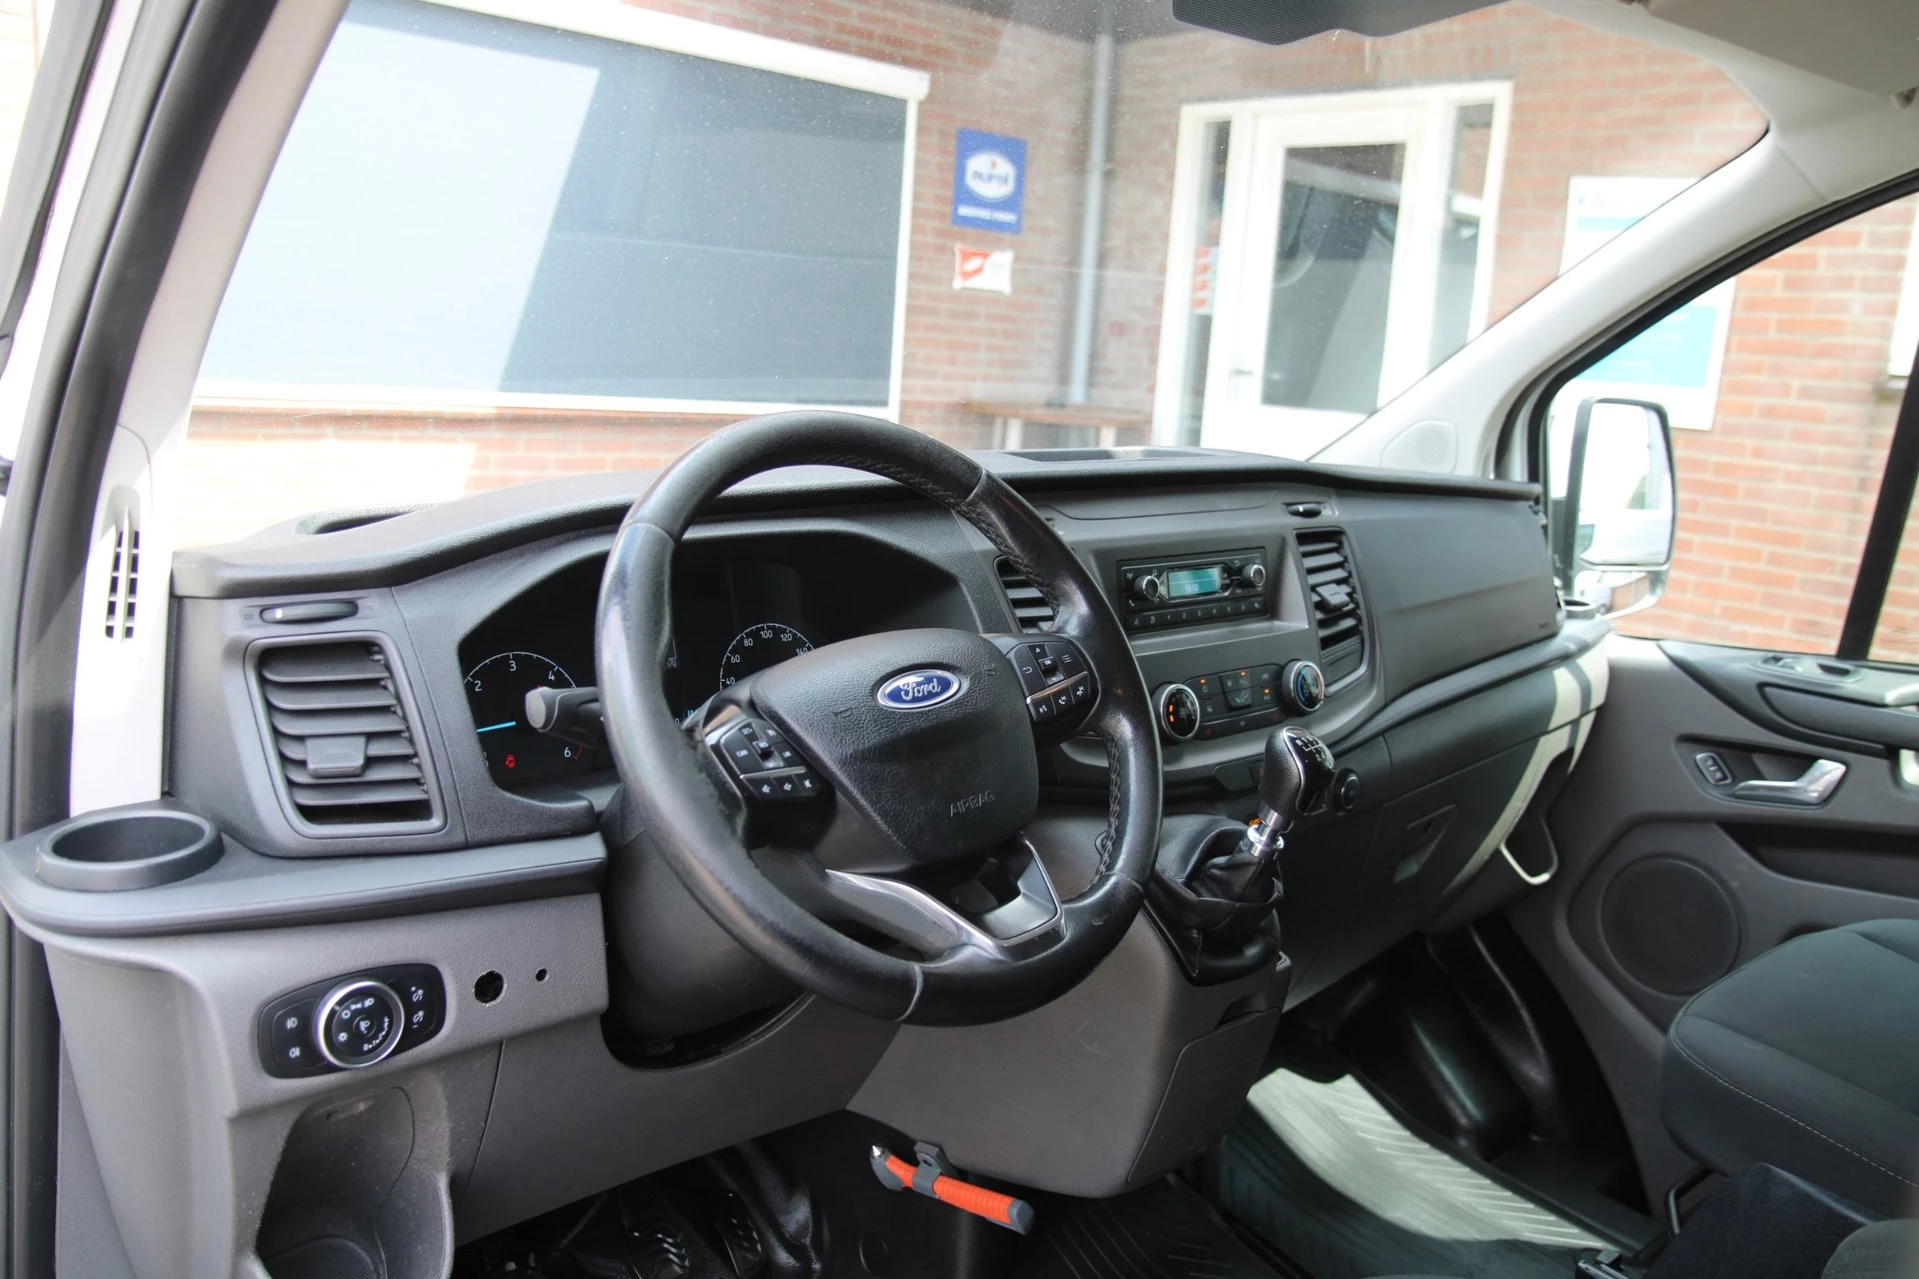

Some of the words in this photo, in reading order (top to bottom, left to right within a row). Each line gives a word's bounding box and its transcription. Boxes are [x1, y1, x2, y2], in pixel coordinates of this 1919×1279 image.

[760, 630, 773, 639] 100
[780, 633, 793, 642] 120
[743, 638, 754, 647] 80
[730, 654, 741, 664] 60
[508, 660, 517, 672] 3
[548, 670, 555, 681] 4
[725, 676, 736, 686] 40
[474, 680, 482, 692] 2
[900, 677, 942, 701] Ford
[564, 746, 572, 758] 6
[950, 790, 996, 818] AIRBAG
